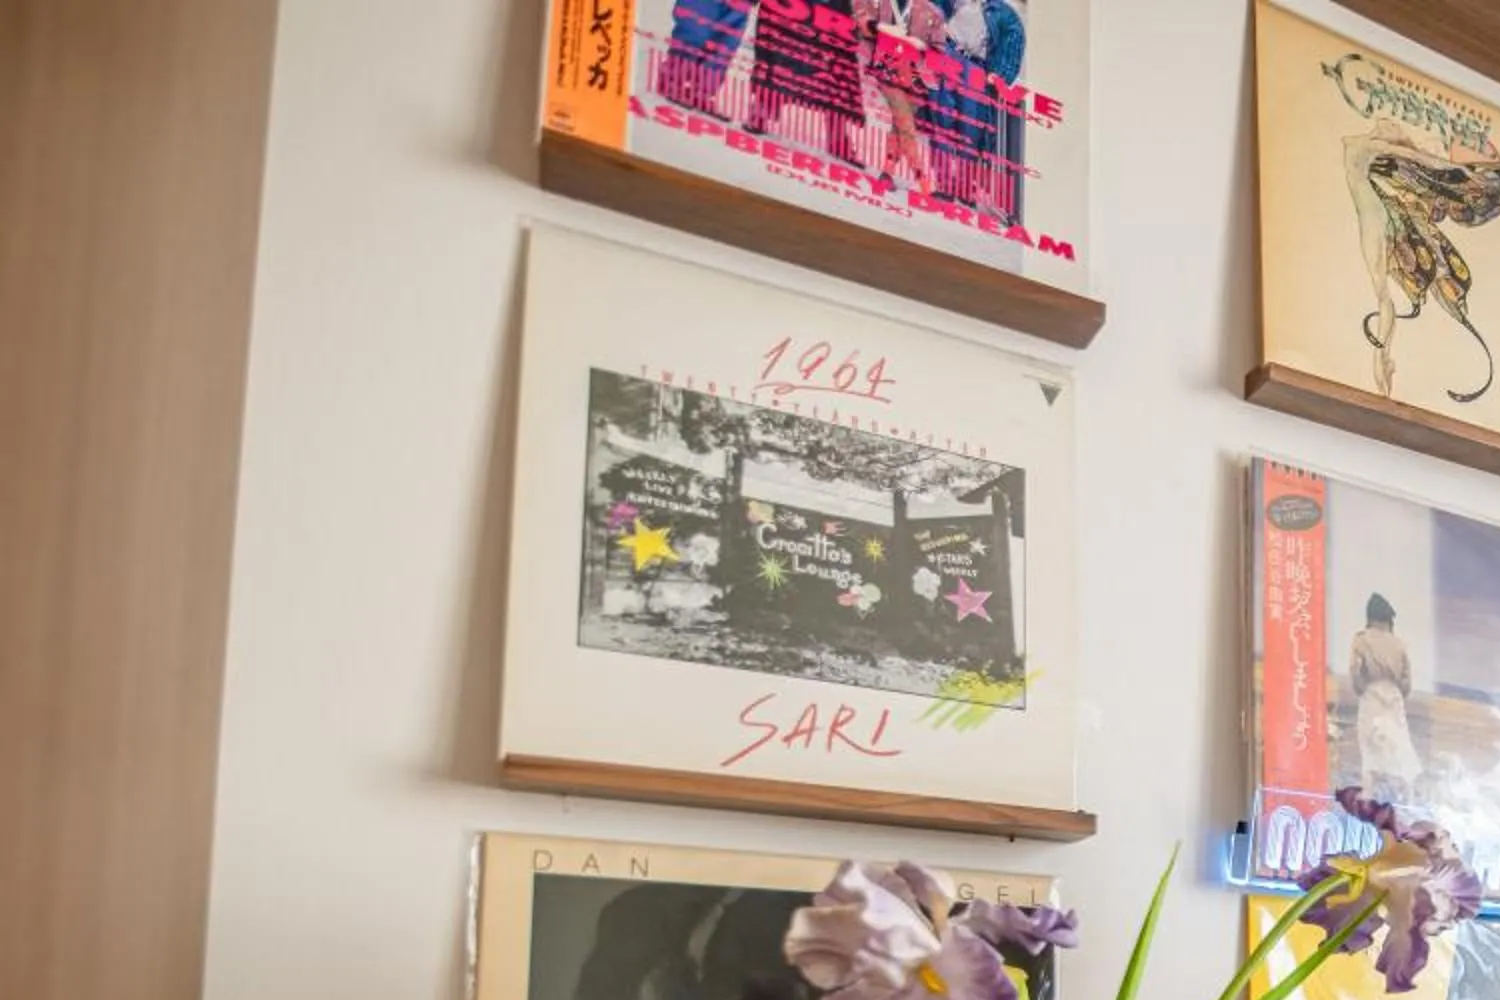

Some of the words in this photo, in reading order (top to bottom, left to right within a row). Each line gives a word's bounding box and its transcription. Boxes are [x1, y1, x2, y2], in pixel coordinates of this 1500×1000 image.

[627, 95, 896, 197] ASPBERRY
[907, 188, 1076, 262] DREAM
[759, 336, 897, 397] 1964
[532, 848, 650, 878] DAN
